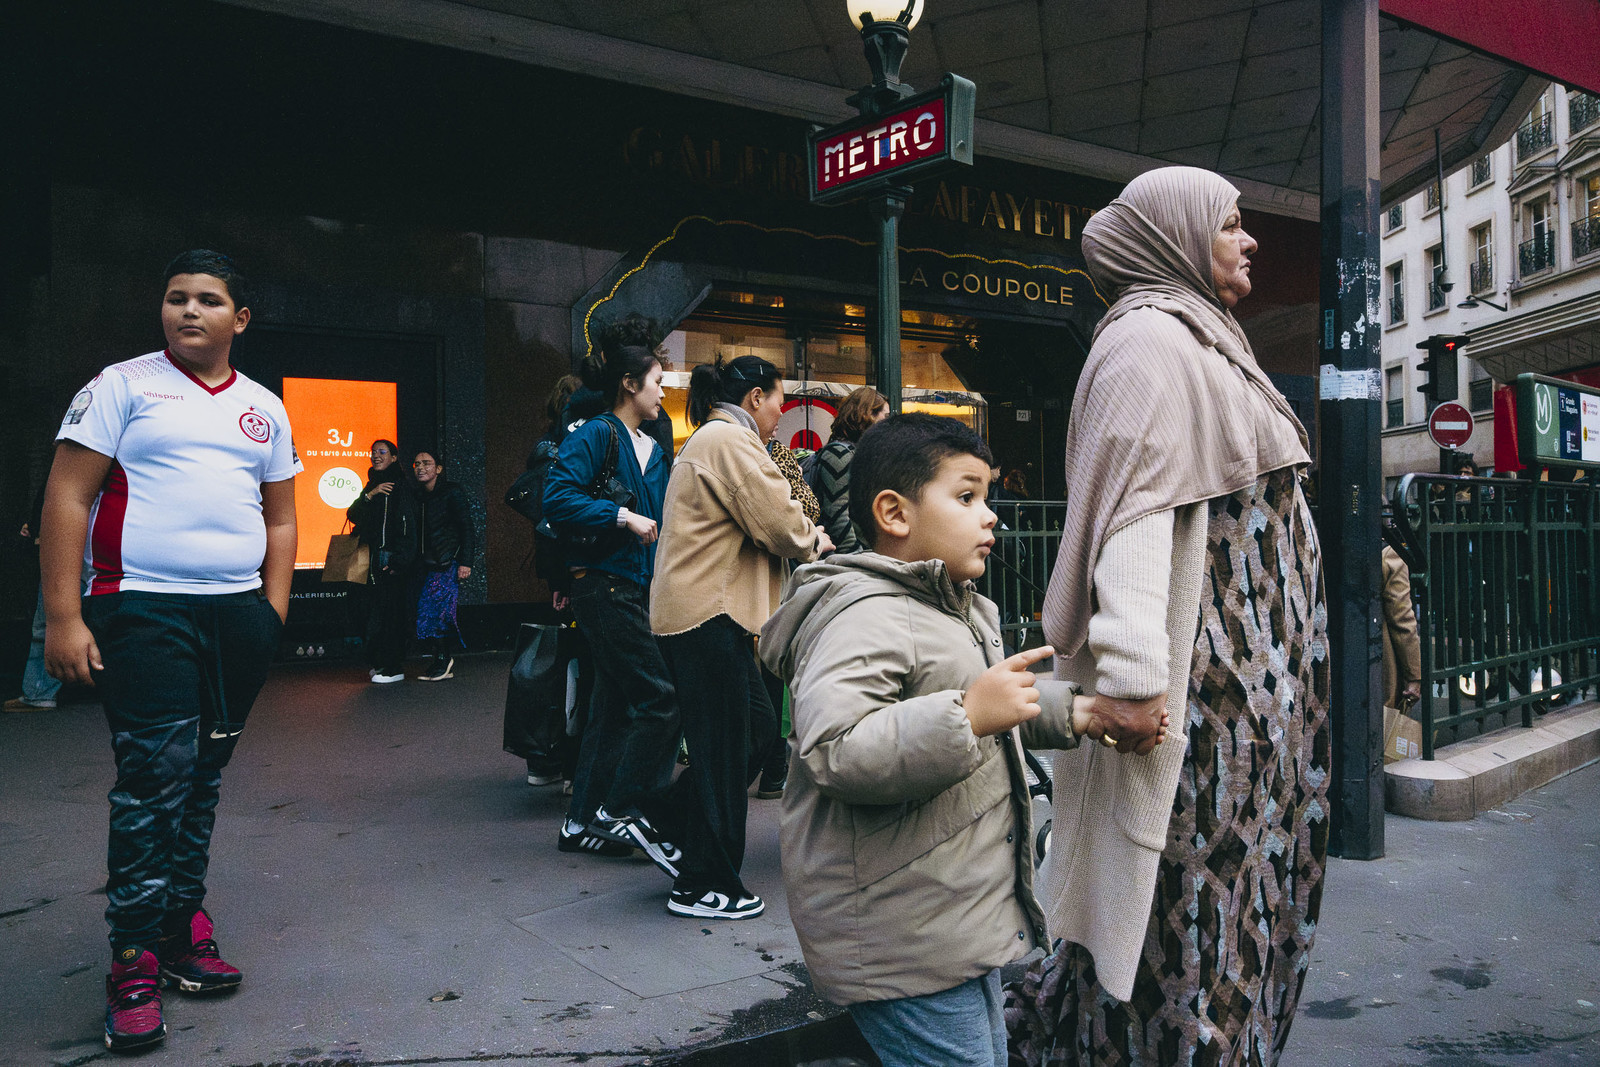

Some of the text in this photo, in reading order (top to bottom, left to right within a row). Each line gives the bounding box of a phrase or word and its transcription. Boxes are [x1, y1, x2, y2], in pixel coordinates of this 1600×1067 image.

[824, 111, 937, 182] METRO
[942, 270, 1075, 306] COUPOLE
[143, 391, 184, 401] uhlsport
[327, 428, 353, 447] 3J
